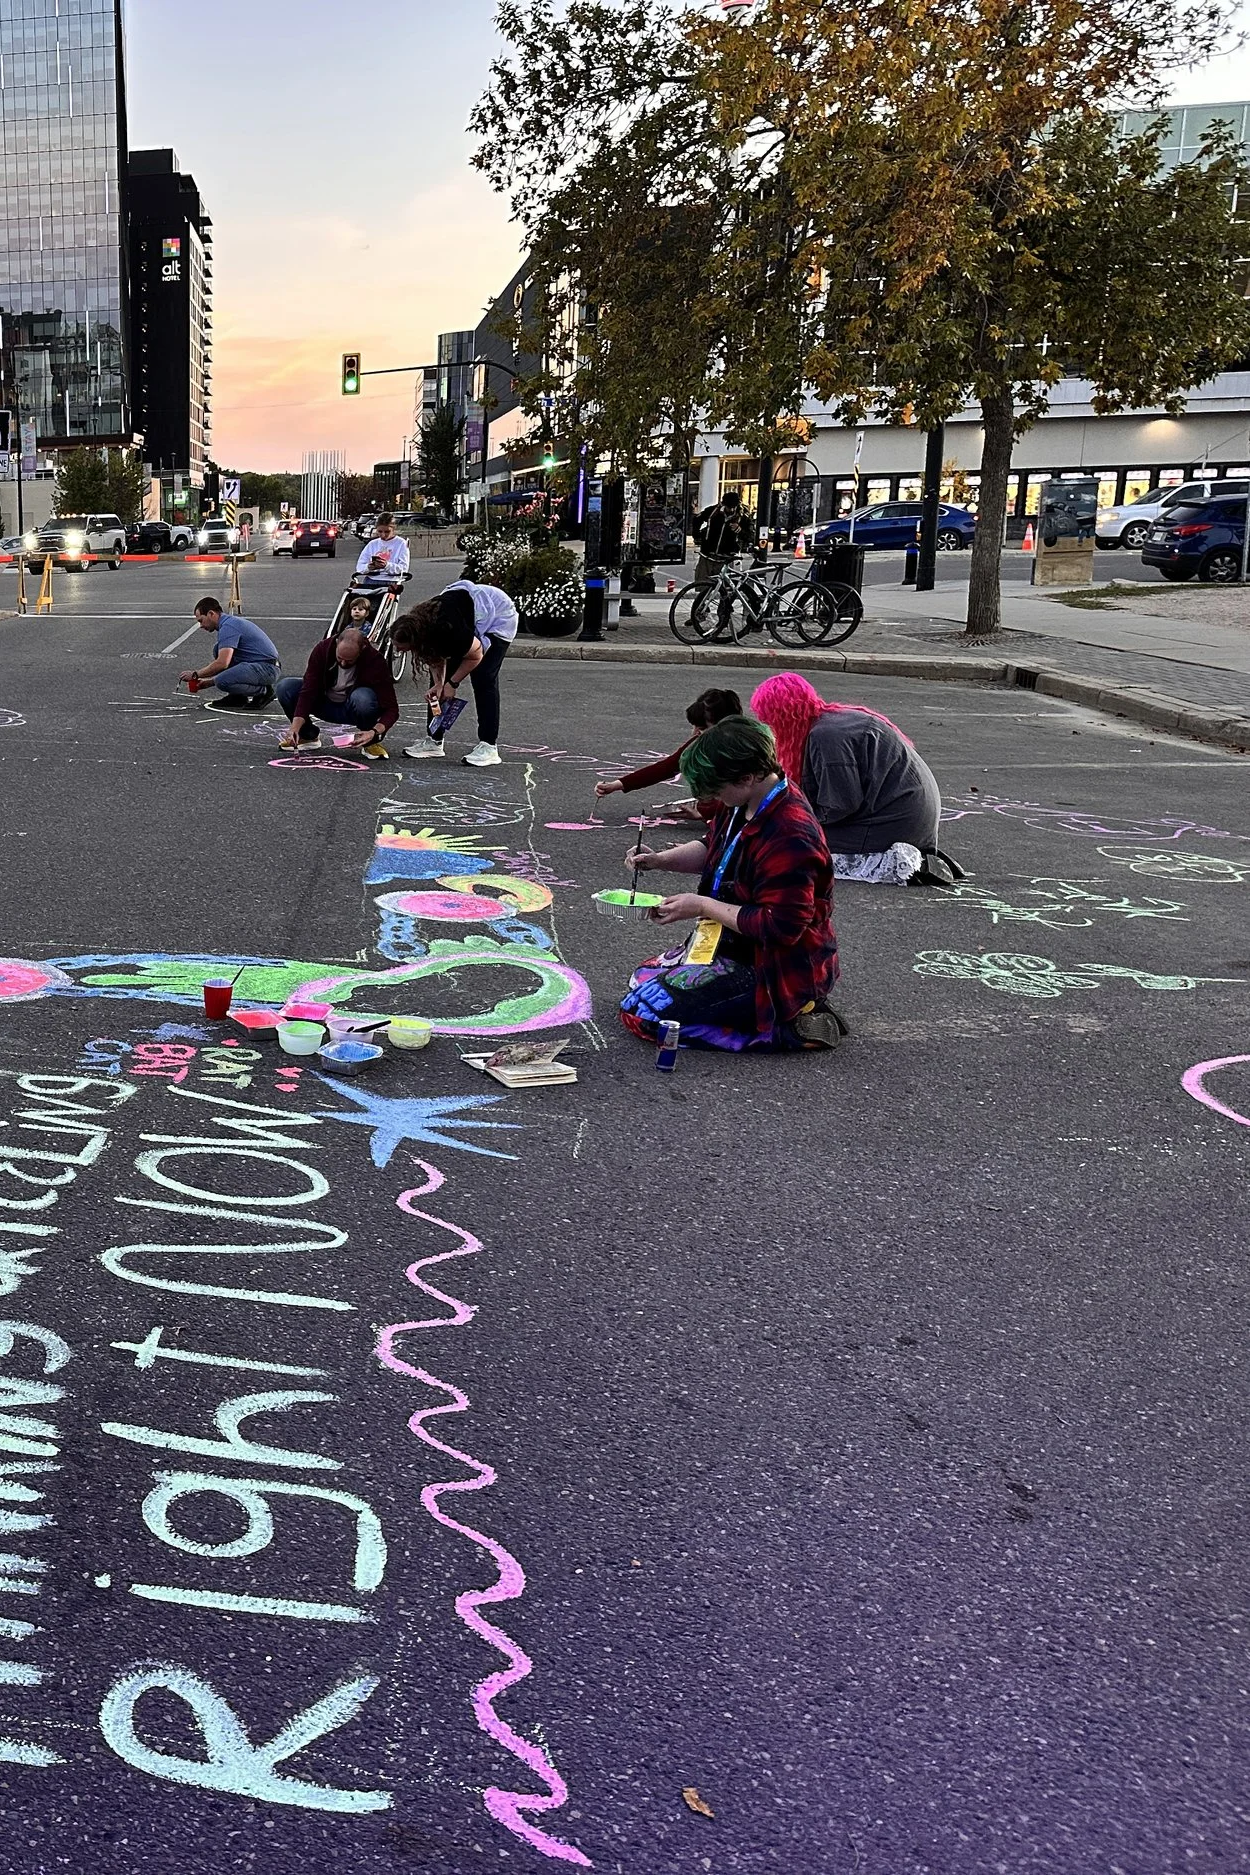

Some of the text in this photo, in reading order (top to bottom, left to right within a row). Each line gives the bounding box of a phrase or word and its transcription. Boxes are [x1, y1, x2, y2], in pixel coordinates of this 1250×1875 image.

[162, 260, 181, 275] alt
[75, 1037, 134, 1076] CAT
[127, 1043, 197, 1084] BAT
[199, 1046, 263, 1089] RAT
[100, 1082, 357, 1312] NOW
